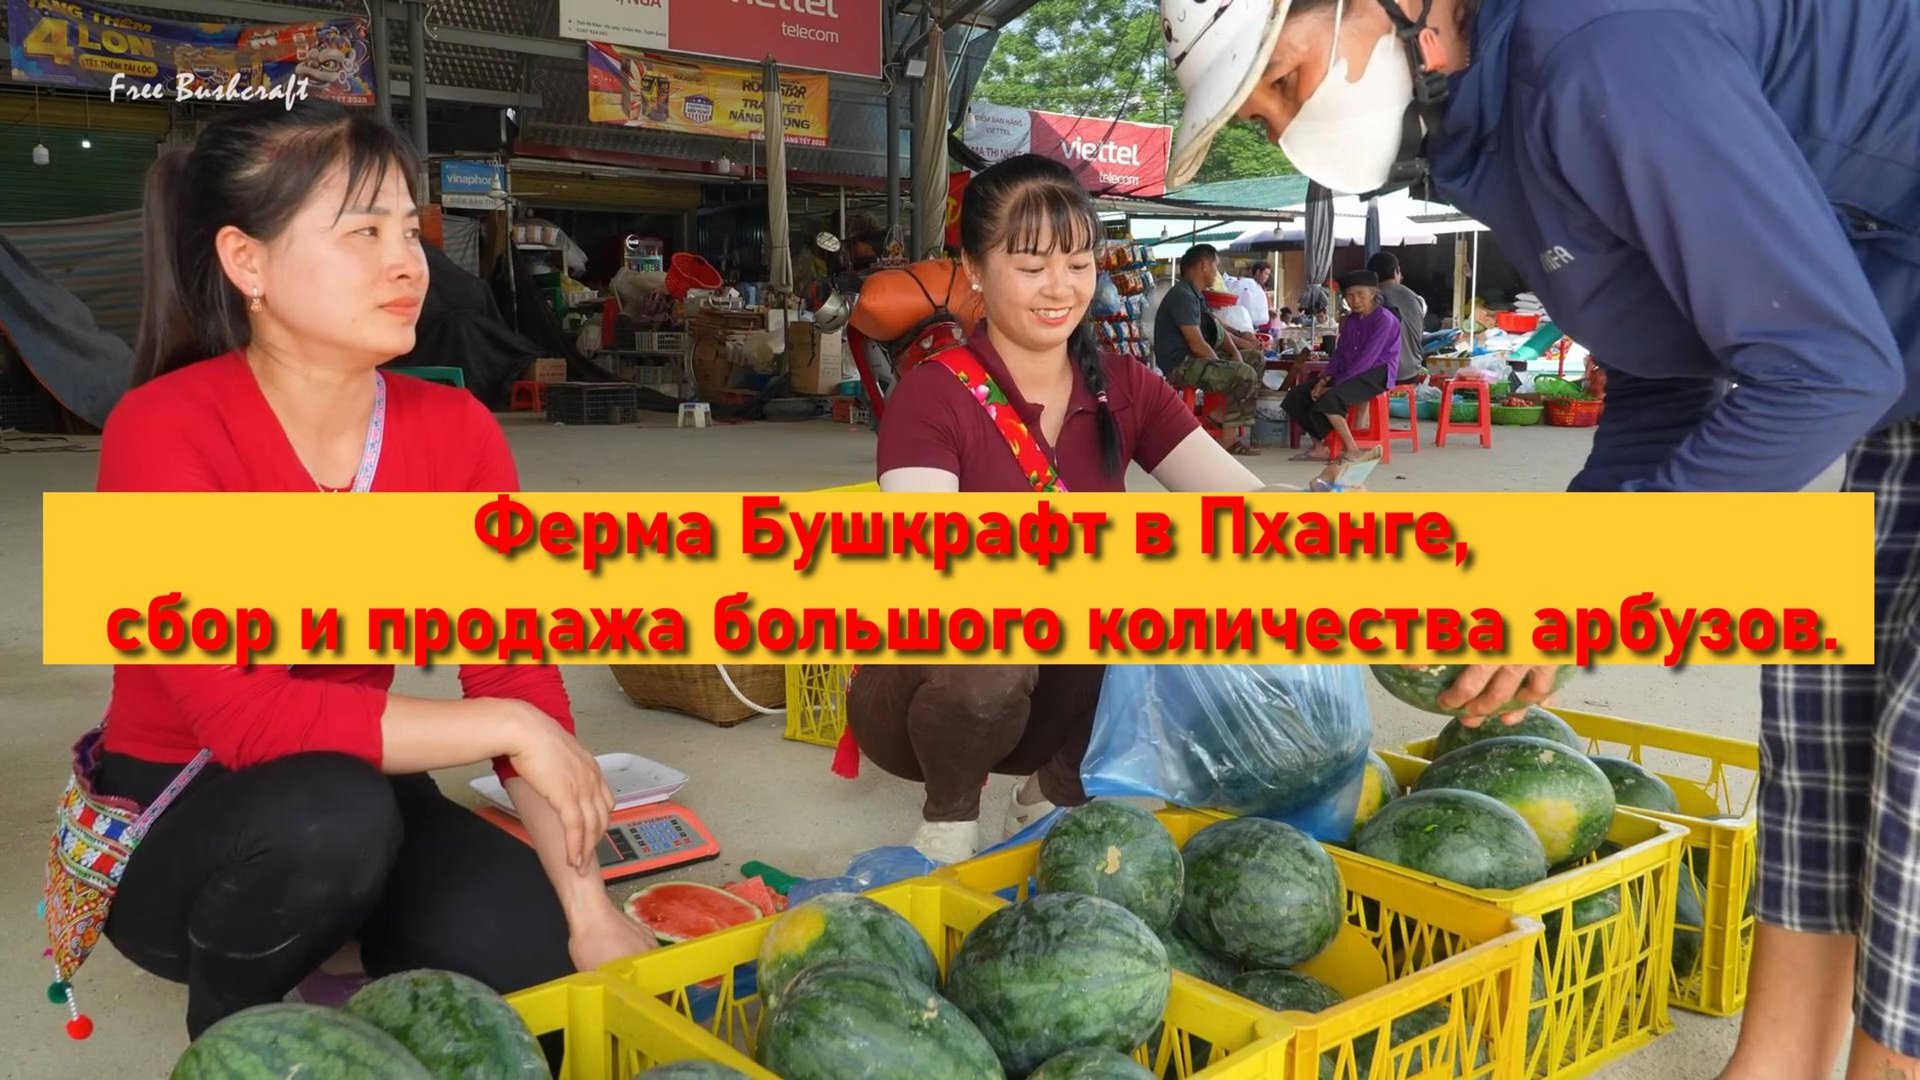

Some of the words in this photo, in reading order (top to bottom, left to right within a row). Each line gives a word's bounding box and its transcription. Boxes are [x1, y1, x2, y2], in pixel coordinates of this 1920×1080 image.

[24, 16, 75, 66] 4
[78, 23, 157, 58] LON
[781, 21, 839, 43] telecom
[1060, 136, 1141, 167] viettel
[446, 172, 493, 186] vinapho
[1099, 171, 1139, 187] telecom
